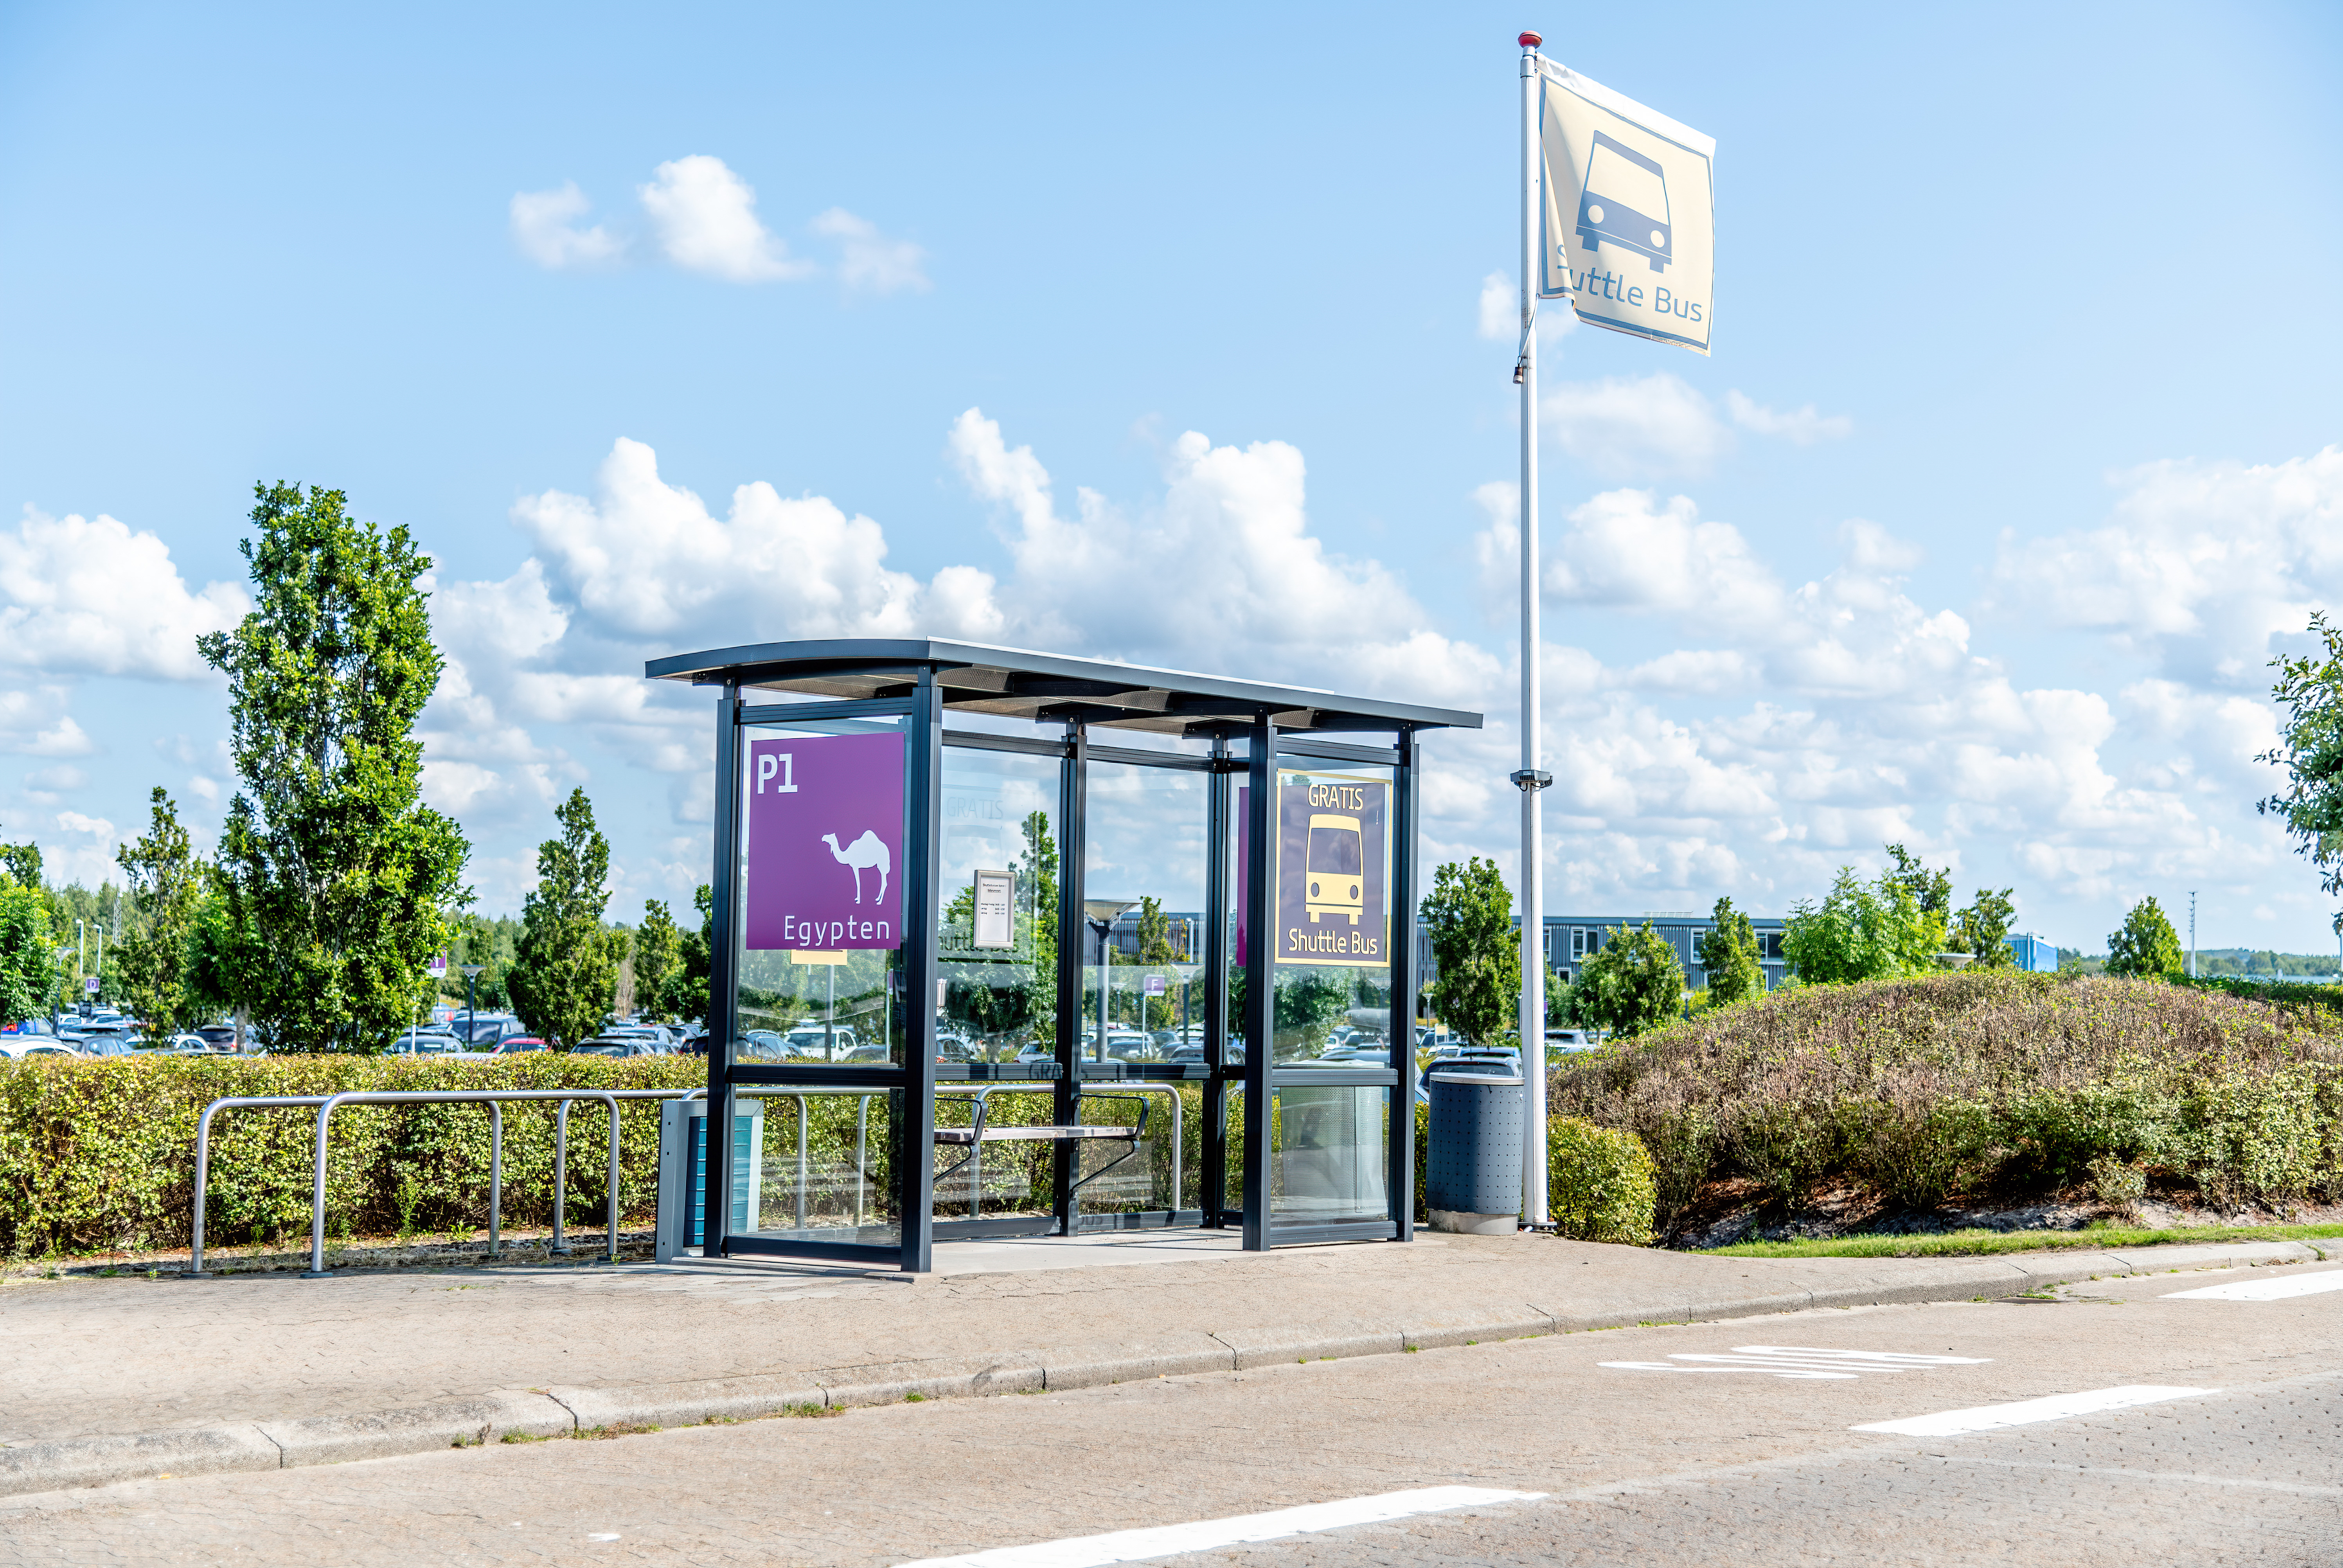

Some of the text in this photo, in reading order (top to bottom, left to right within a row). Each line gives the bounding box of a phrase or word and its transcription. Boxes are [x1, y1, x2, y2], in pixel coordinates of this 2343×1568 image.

[1557, 244, 1702, 322] Suttle Bus
[757, 753, 798, 794] P1
[947, 797, 1004, 820] GRATIS
[1308, 784, 1364, 810] GRATIS
[784, 915, 890, 946] Egypten
[1288, 928, 1378, 955] Shuttle Bus
[90, 980, 96, 989] D
[1152, 980, 1158, 990] F
